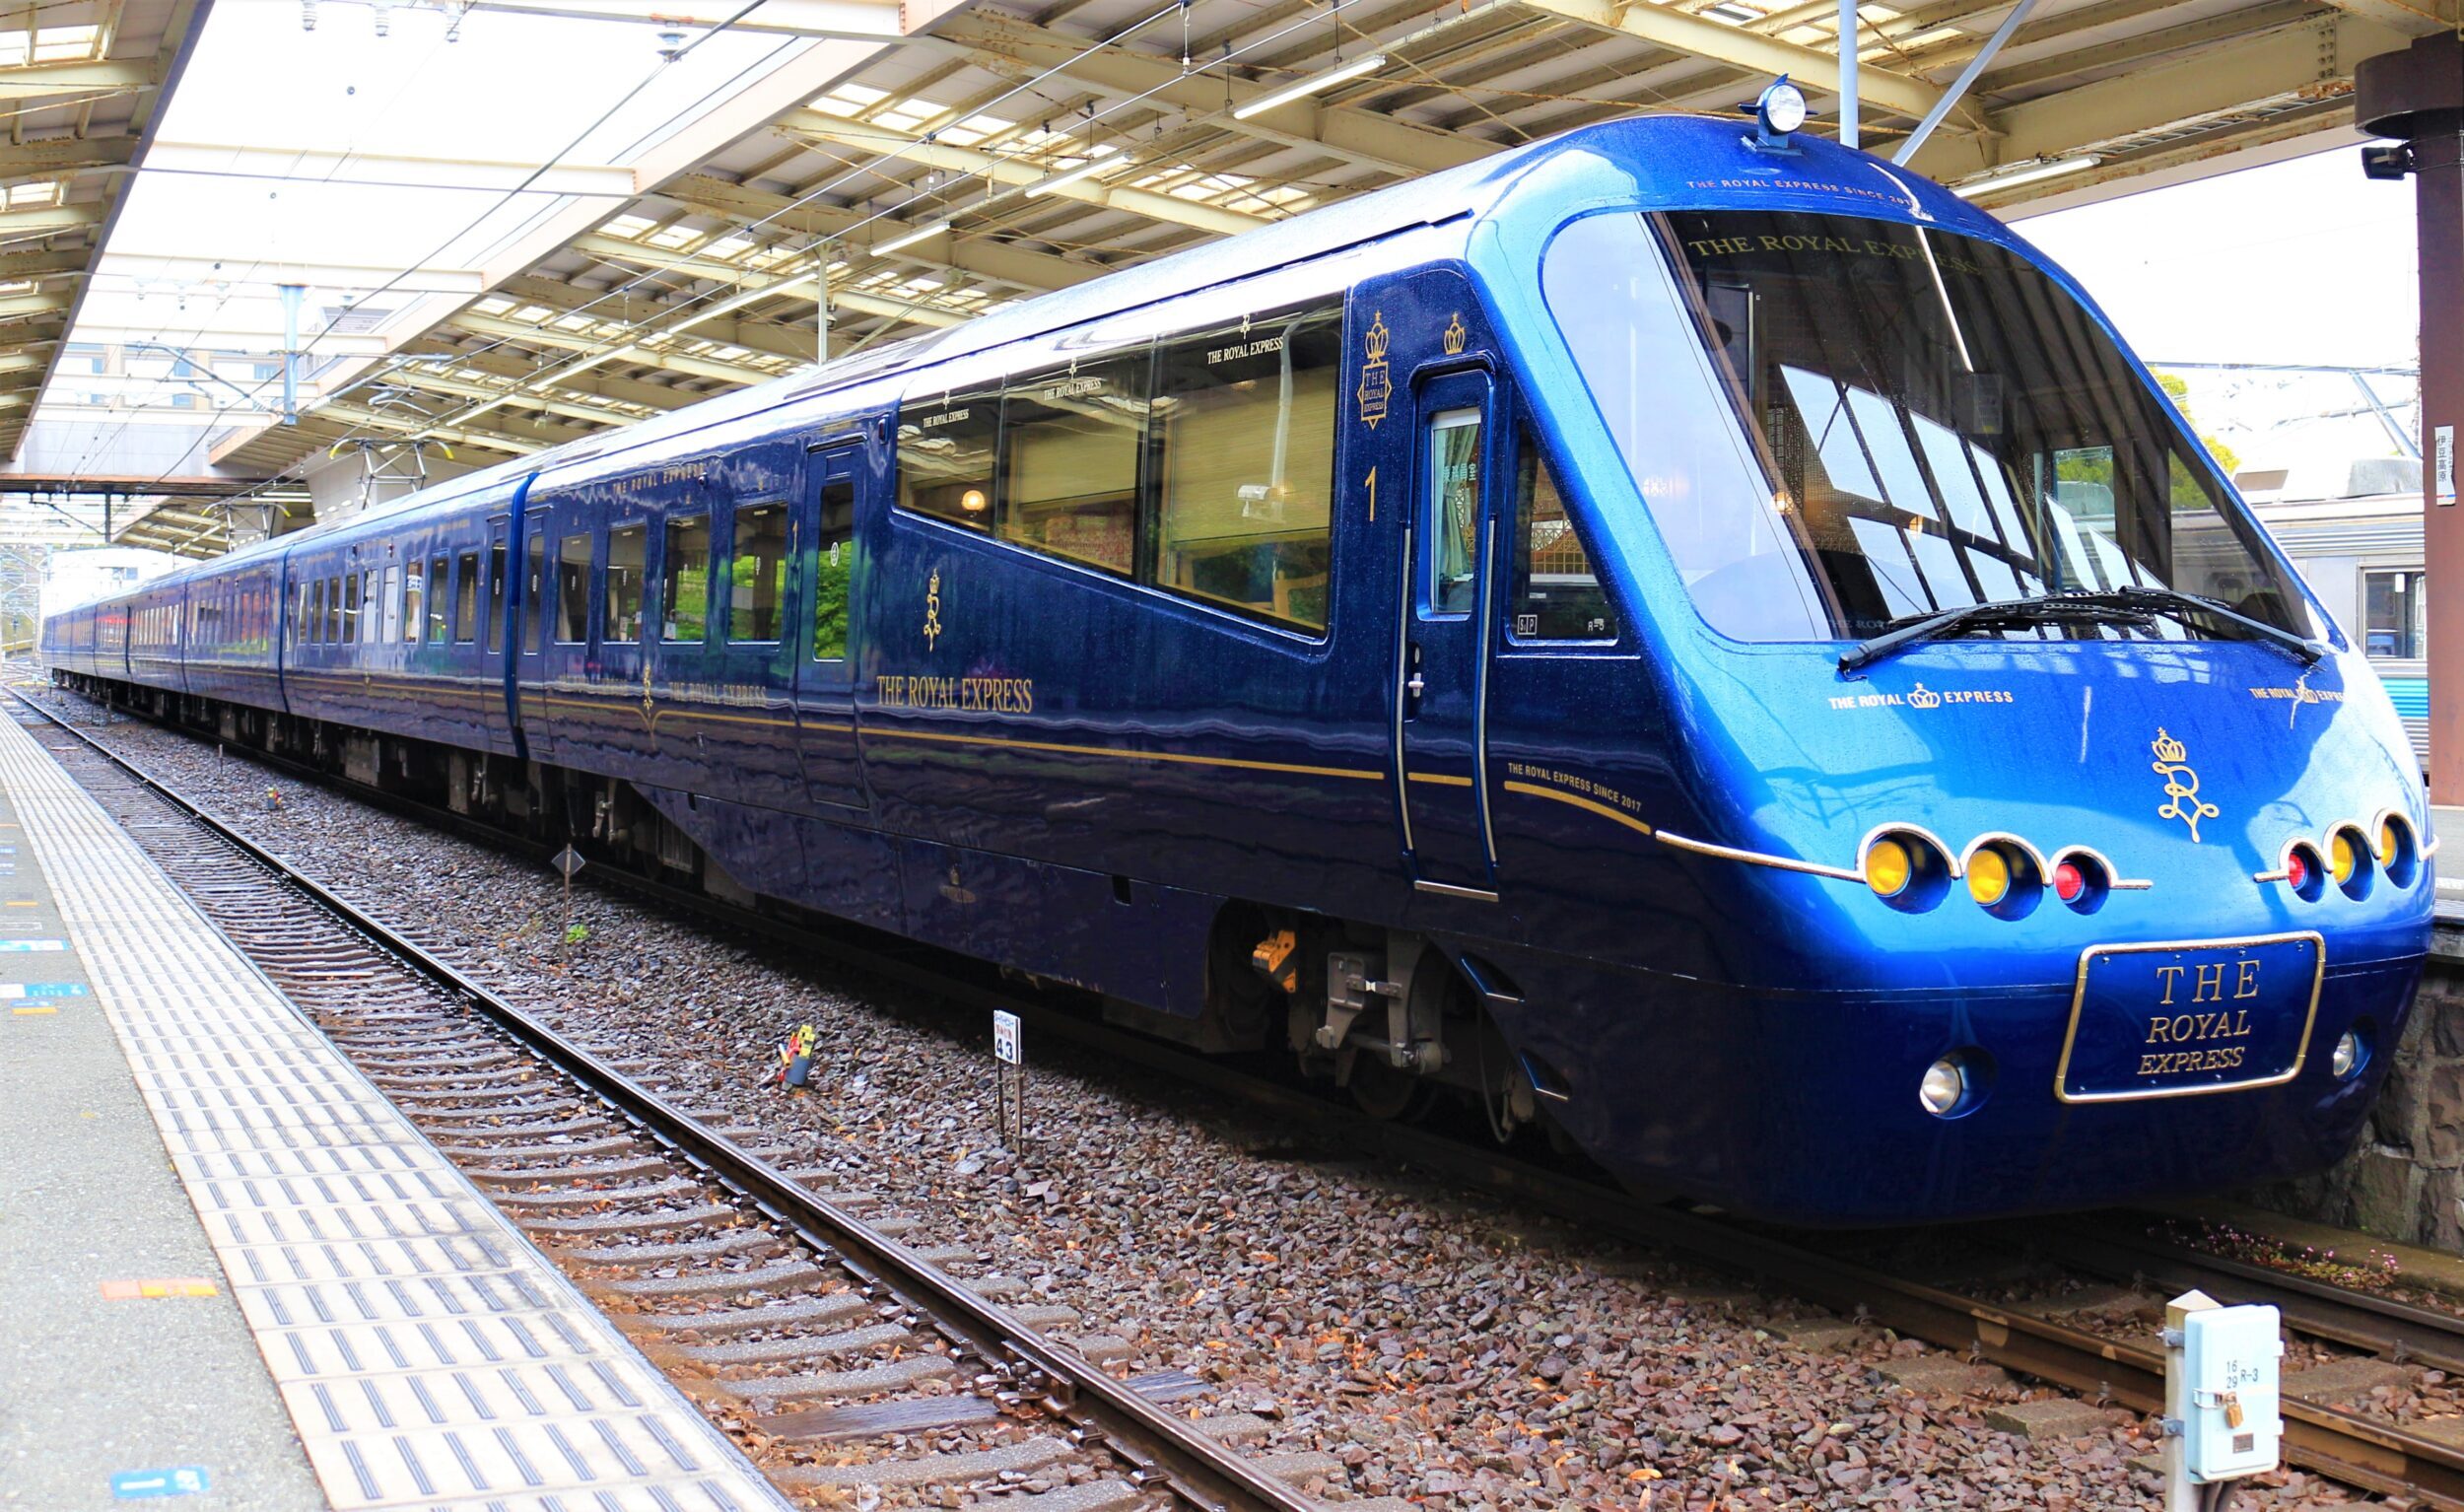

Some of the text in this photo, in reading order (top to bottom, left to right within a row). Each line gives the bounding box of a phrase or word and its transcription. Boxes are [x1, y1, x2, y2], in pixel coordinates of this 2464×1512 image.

[1686, 180, 1717, 189] THE
[1775, 180, 1840, 191] EXPRESS
[1844, 186, 1884, 200] SINCE
[1687, 237, 1754, 256] THE
[1757, 236, 1861, 252] ROYAL
[1207, 336, 1284, 365] THE ROYAL EXPRESS
[1365, 370, 1386, 386] THE
[1364, 465, 1376, 521] 1
[876, 675, 1033, 714] THE ROYAL EXPRESS
[1828, 691, 2014, 710] THE ROYAL EXPRESS
[2248, 688, 2270, 699] THE
[1508, 762, 1642, 812] THE ROYAL EXPRESS SINCE 2017
[2156, 960, 2260, 1004] THE
[2146, 1009, 2251, 1043] ROYAL
[996, 1038, 1013, 1061] 43
[2137, 1046, 2245, 1075] EXPRESS
[2226, 1360, 2237, 1373] 16
[2240, 1368, 2259, 1382] R-3
[2226, 1376, 2238, 1389] 29
